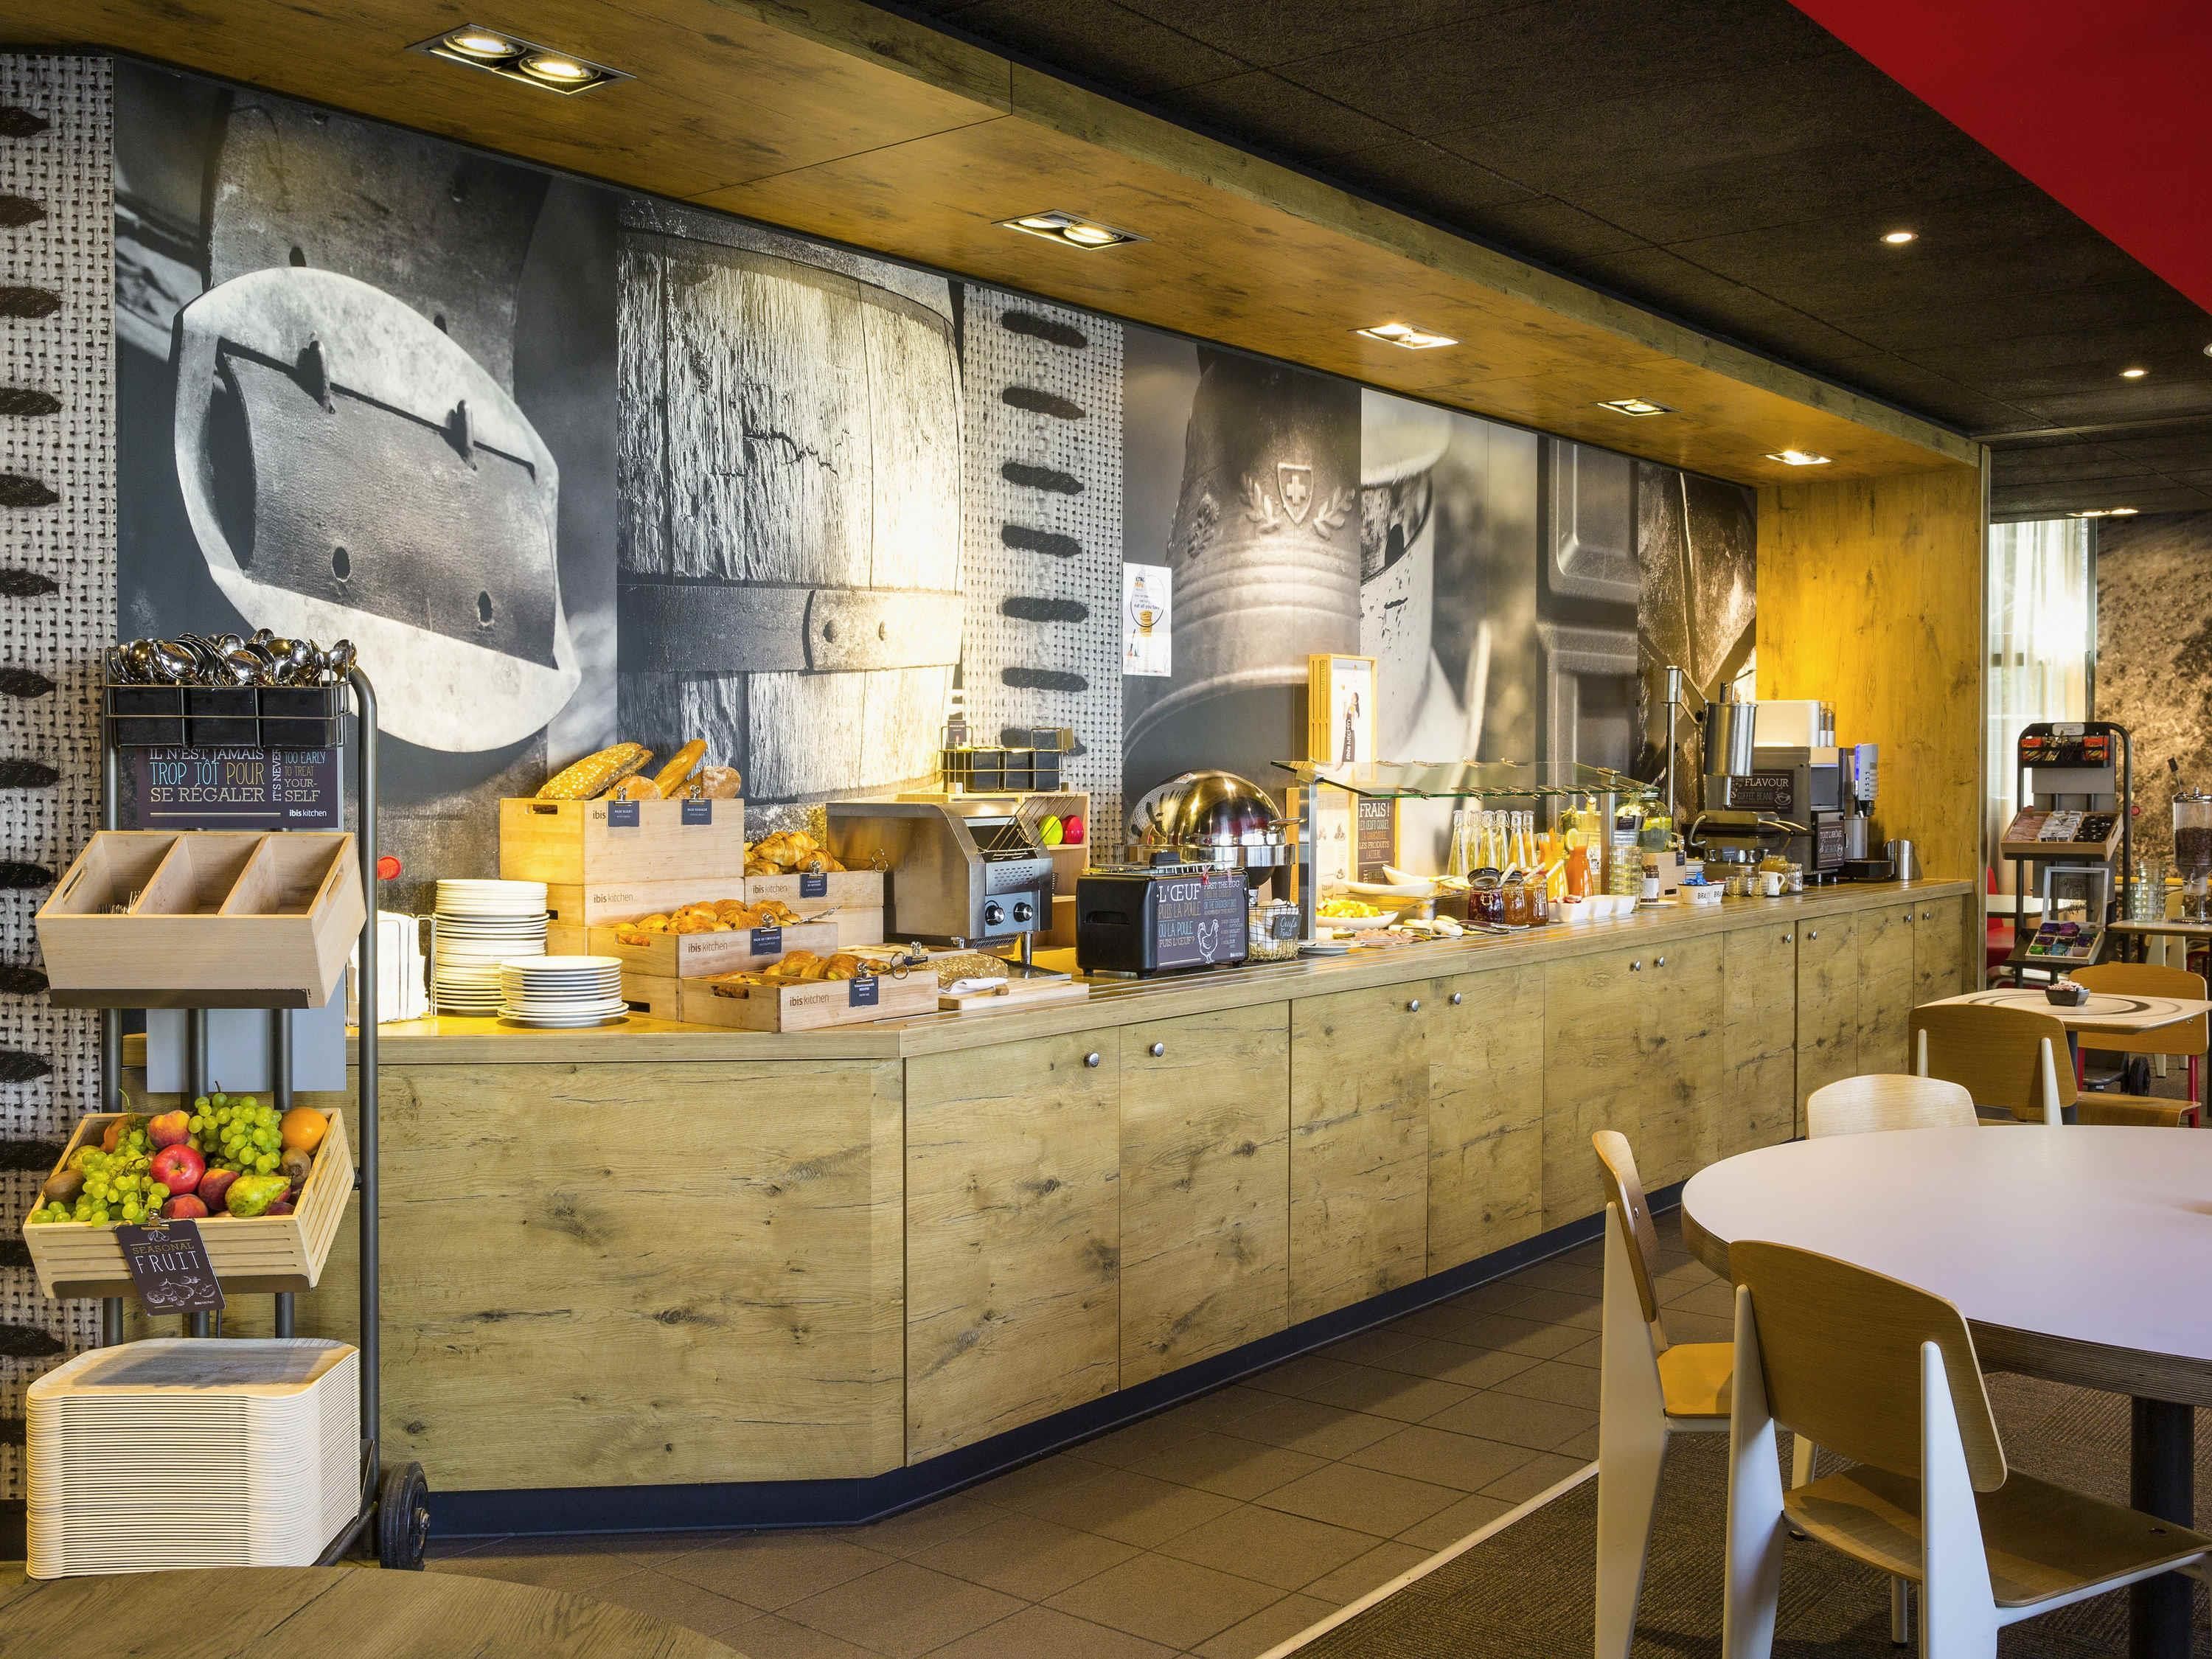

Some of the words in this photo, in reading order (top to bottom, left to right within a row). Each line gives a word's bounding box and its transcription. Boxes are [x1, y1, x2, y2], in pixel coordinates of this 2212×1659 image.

[149, 748, 163, 759] IL
[164, 748, 209, 759] N'EST
[211, 748, 265, 763] JAMAIS
[284, 751, 298, 764] TOO
[301, 751, 326, 764] EARLY
[150, 762, 187, 785] TROP
[195, 759, 220, 785] TÔT
[226, 762, 265, 785] POUR
[284, 765, 292, 776] TO
[293, 765, 314, 776] TREAT
[284, 779, 318, 787] YOUR-
[1745, 778, 1789, 787] FLAVOUR
[150, 787, 173, 802] SE
[178, 784, 265, 802] RÉGALER
[272, 784, 282, 801] IT'S
[285, 790, 321, 802] SELF
[289, 809, 302, 817] ibis
[302, 809, 327, 817] kitchen
[592, 810, 606, 820] ibis
[753, 884, 765, 894] ibis
[765, 884, 787, 893] kitchen
[594, 894, 607, 903] ibis
[608, 892, 634, 902] kitchen
[688, 942, 701, 953] ibis
[701, 942, 728, 952] kitchen
[790, 995, 803, 1006] ibis
[803, 993, 830, 1005] kitchen
[132, 1242, 195, 1255] SEASONAL
[135, 1251, 200, 1273] FRUIT
